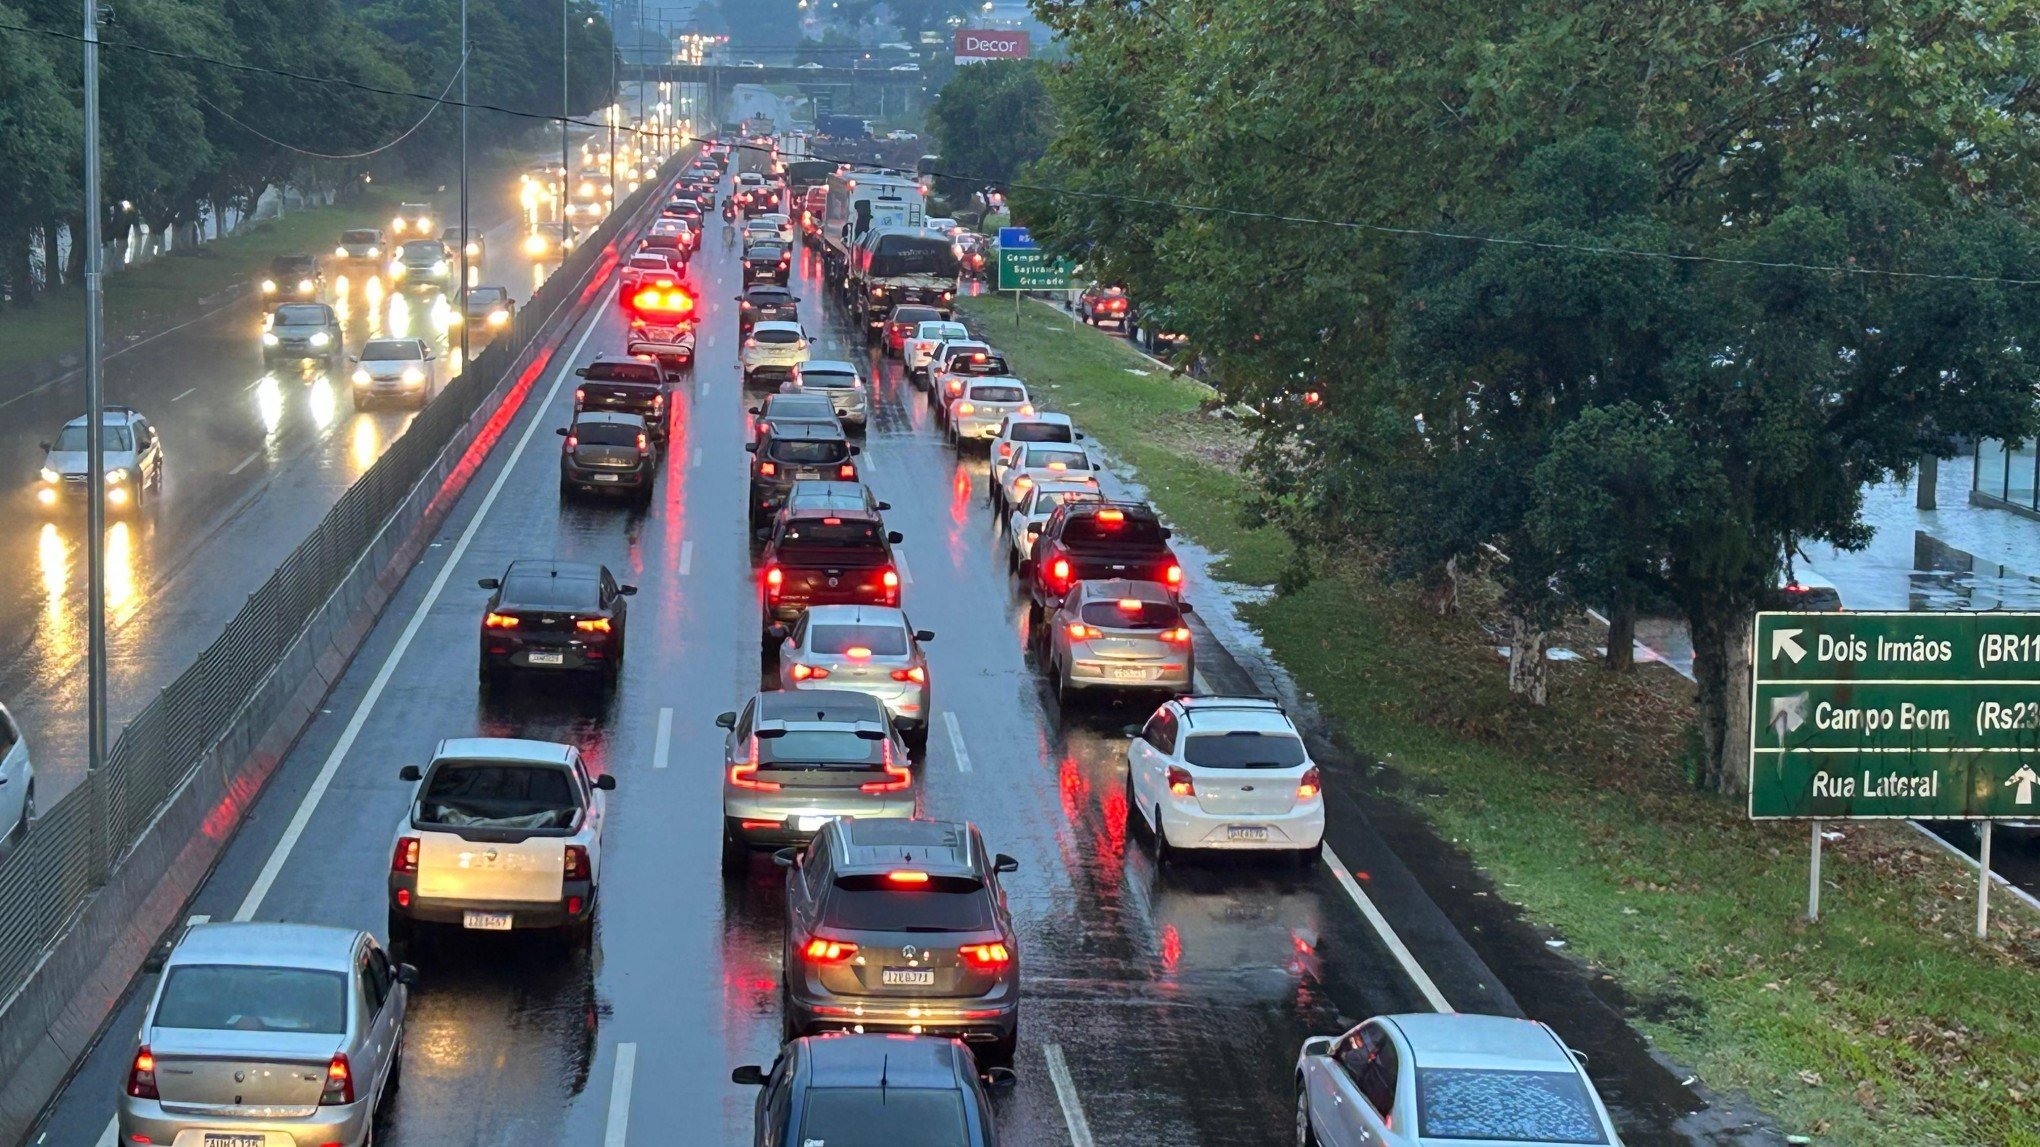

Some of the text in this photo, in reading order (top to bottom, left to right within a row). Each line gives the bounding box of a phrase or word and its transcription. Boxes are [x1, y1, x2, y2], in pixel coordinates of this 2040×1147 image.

[966, 37, 1018, 52] Decor
[1007, 254, 1040, 262] Campo
[1020, 277, 1064, 285] Gramado
[1817, 634, 1867, 662] Dois
[1877, 634, 1952, 662] Irmãos
[1815, 701, 1893, 736] Campo
[1900, 702, 1950, 730] Bom
[1812, 769, 1938, 797] Rua Lateral
